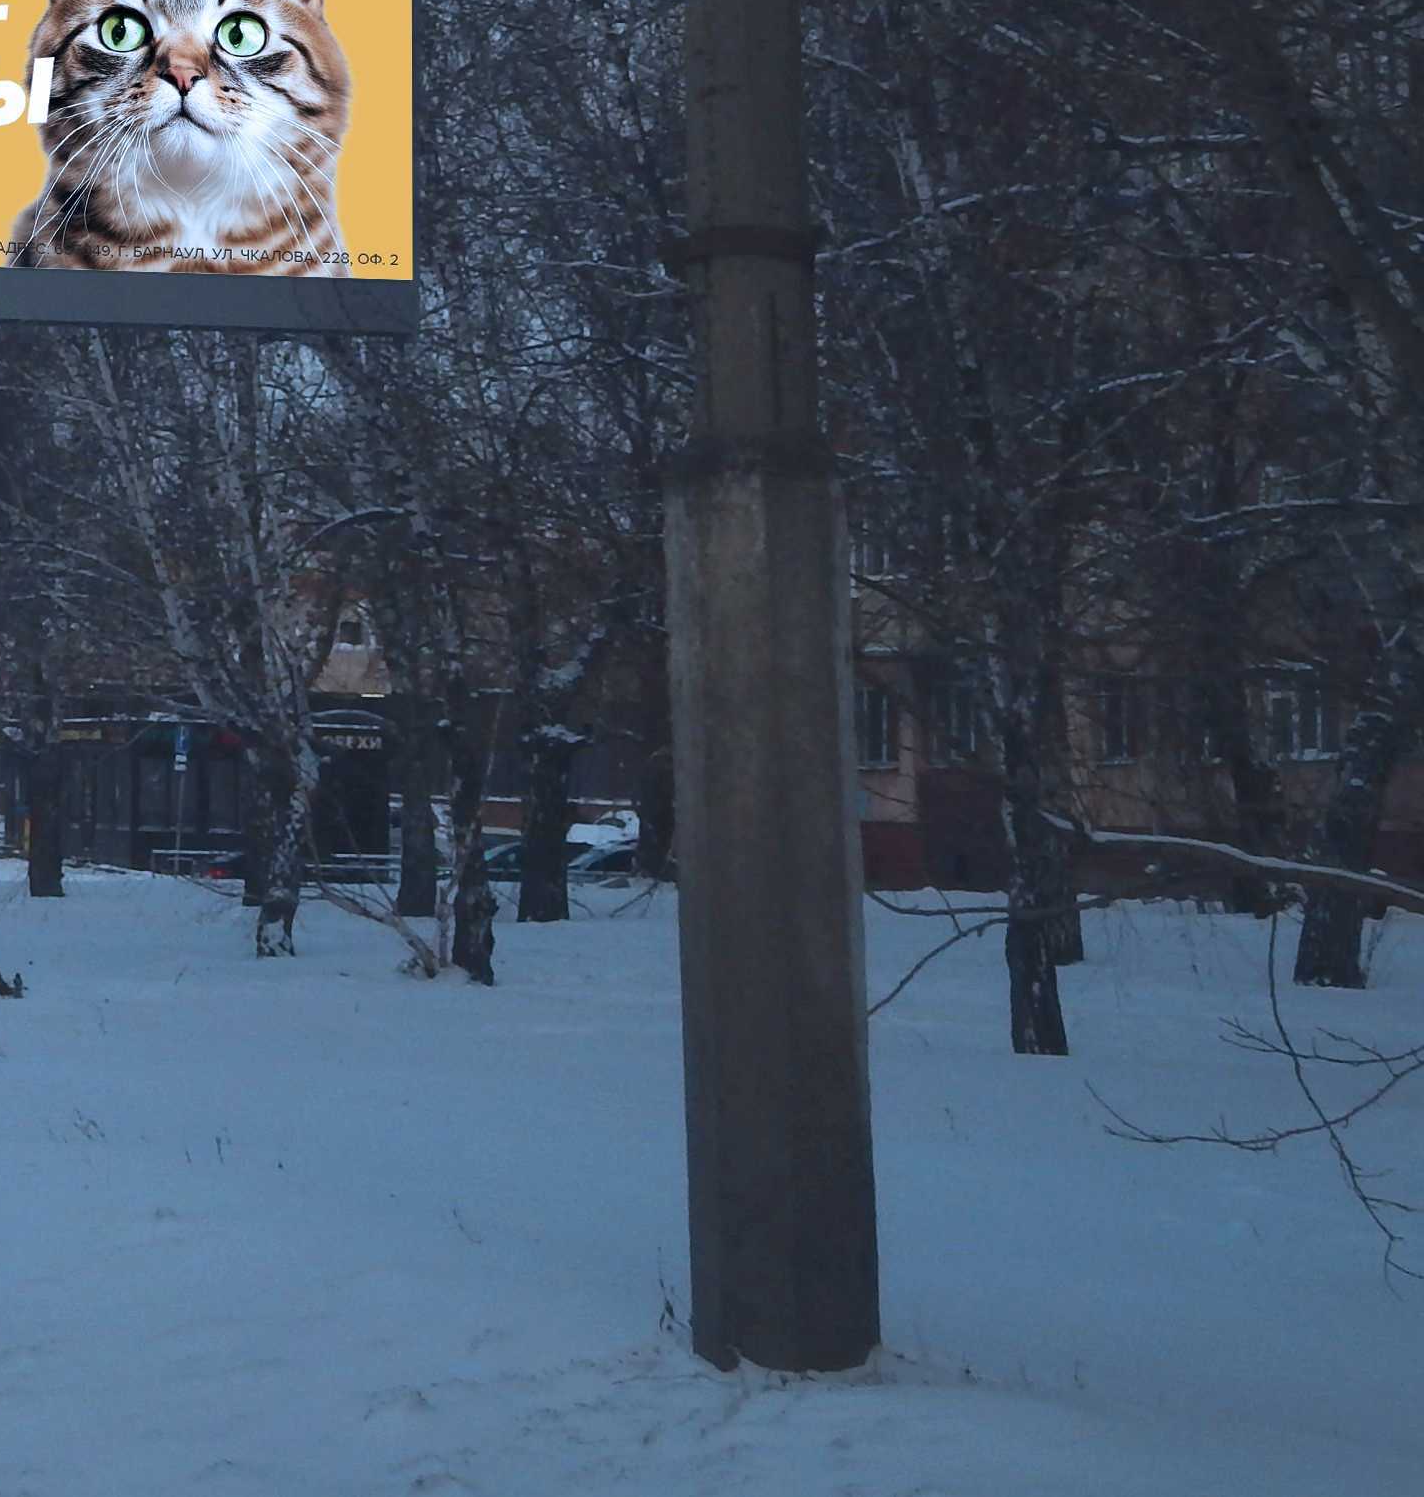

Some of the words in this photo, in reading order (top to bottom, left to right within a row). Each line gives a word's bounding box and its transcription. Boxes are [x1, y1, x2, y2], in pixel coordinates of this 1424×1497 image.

[133, 246, 209, 262] БАРНАУЛ,
[212, 249, 236, 261] УЛ.
[321, 253, 355, 268] 228,
[357, 253, 387, 267] ОФ.
[390, 255, 400, 268] 2
